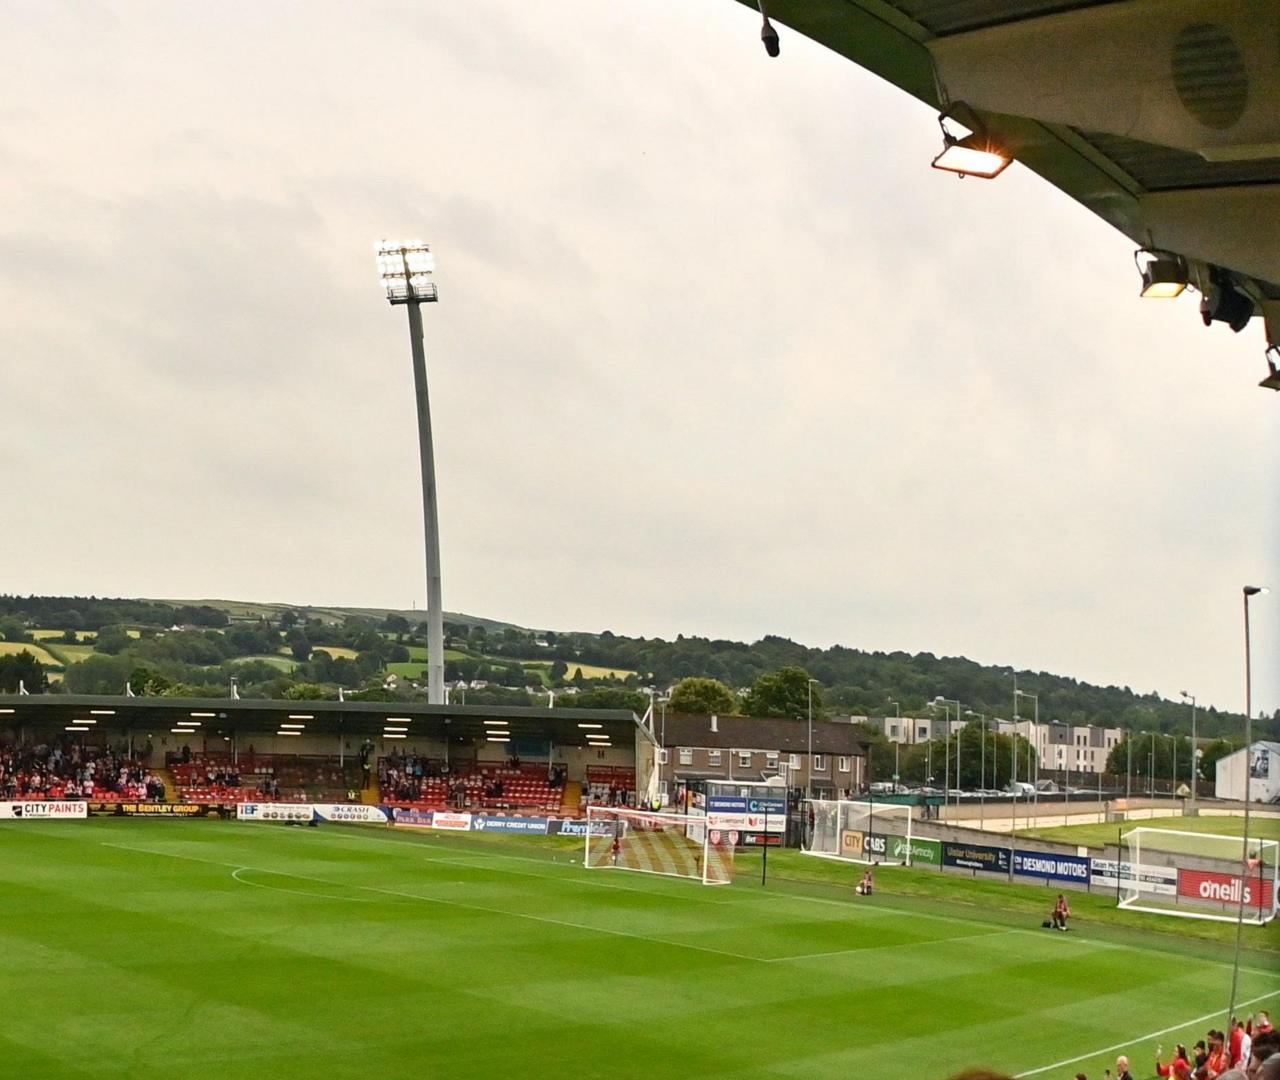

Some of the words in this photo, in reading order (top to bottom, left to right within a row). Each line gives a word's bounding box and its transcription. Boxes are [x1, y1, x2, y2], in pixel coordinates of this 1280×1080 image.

[24, 803, 47, 813] CITY
[48, 803, 84, 813] PAINTS
[121, 804, 136, 812] THE
[137, 803, 172, 813] BENTLEY
[173, 804, 200, 812] GROUP
[486, 820, 506, 828] DERRY
[506, 821, 527, 829] CREDIT
[527, 822, 546, 830] UNION
[844, 835, 861, 849] CITY
[1023, 857, 1056, 875] DESMOND
[1056, 860, 1088, 878] MOTORS
